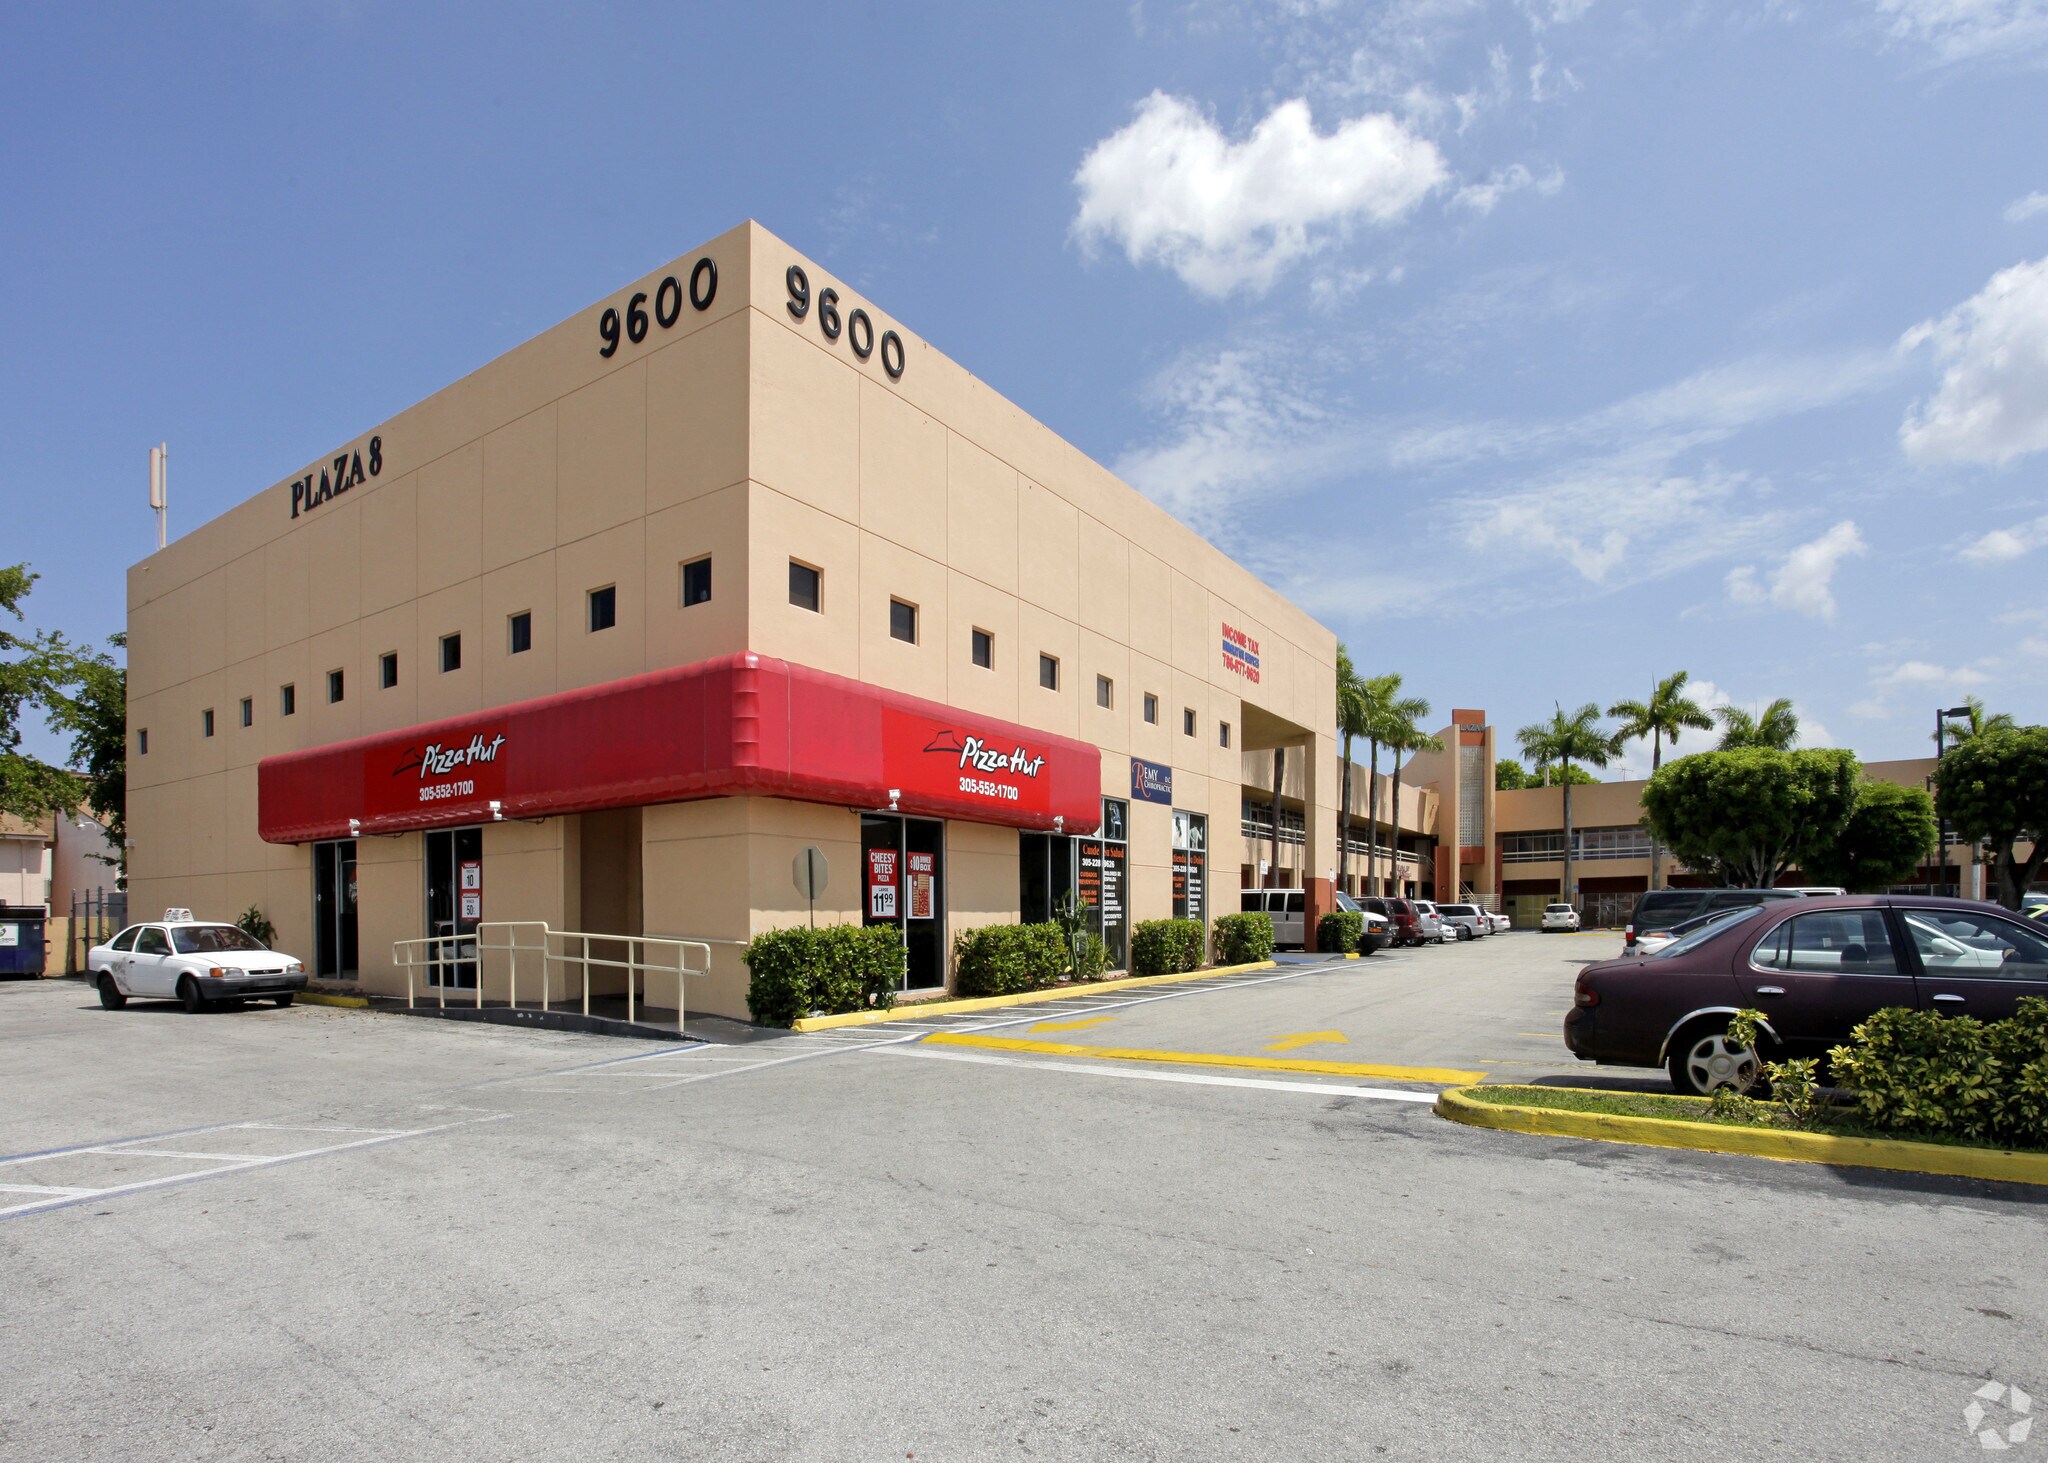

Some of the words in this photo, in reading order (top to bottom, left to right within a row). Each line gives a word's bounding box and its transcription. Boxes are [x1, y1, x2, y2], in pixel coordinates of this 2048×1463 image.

[599, 257, 718, 358] 9600
[786, 265, 906, 378] 9600
[291, 447, 366, 519] PLAZA
[369, 436, 382, 476] 8
[1222, 622, 1247, 649] INCOME
[1247, 637, 1259, 656] TAX
[1460, 723, 1481, 732] LAZA
[420, 743, 465, 779] Pizza
[466, 734, 506, 766] Hut
[959, 736, 1008, 772] Pizza
[1009, 746, 1045, 778] Hut
[419, 780, 474, 802] 305-552-1700
[959, 777, 1018, 800] 305-552-1700
[1131, 762, 1158, 798] REMY
[871, 852, 896, 863] CHEESY
[874, 864, 893, 873] BITES
[911, 856, 919, 871] $10
